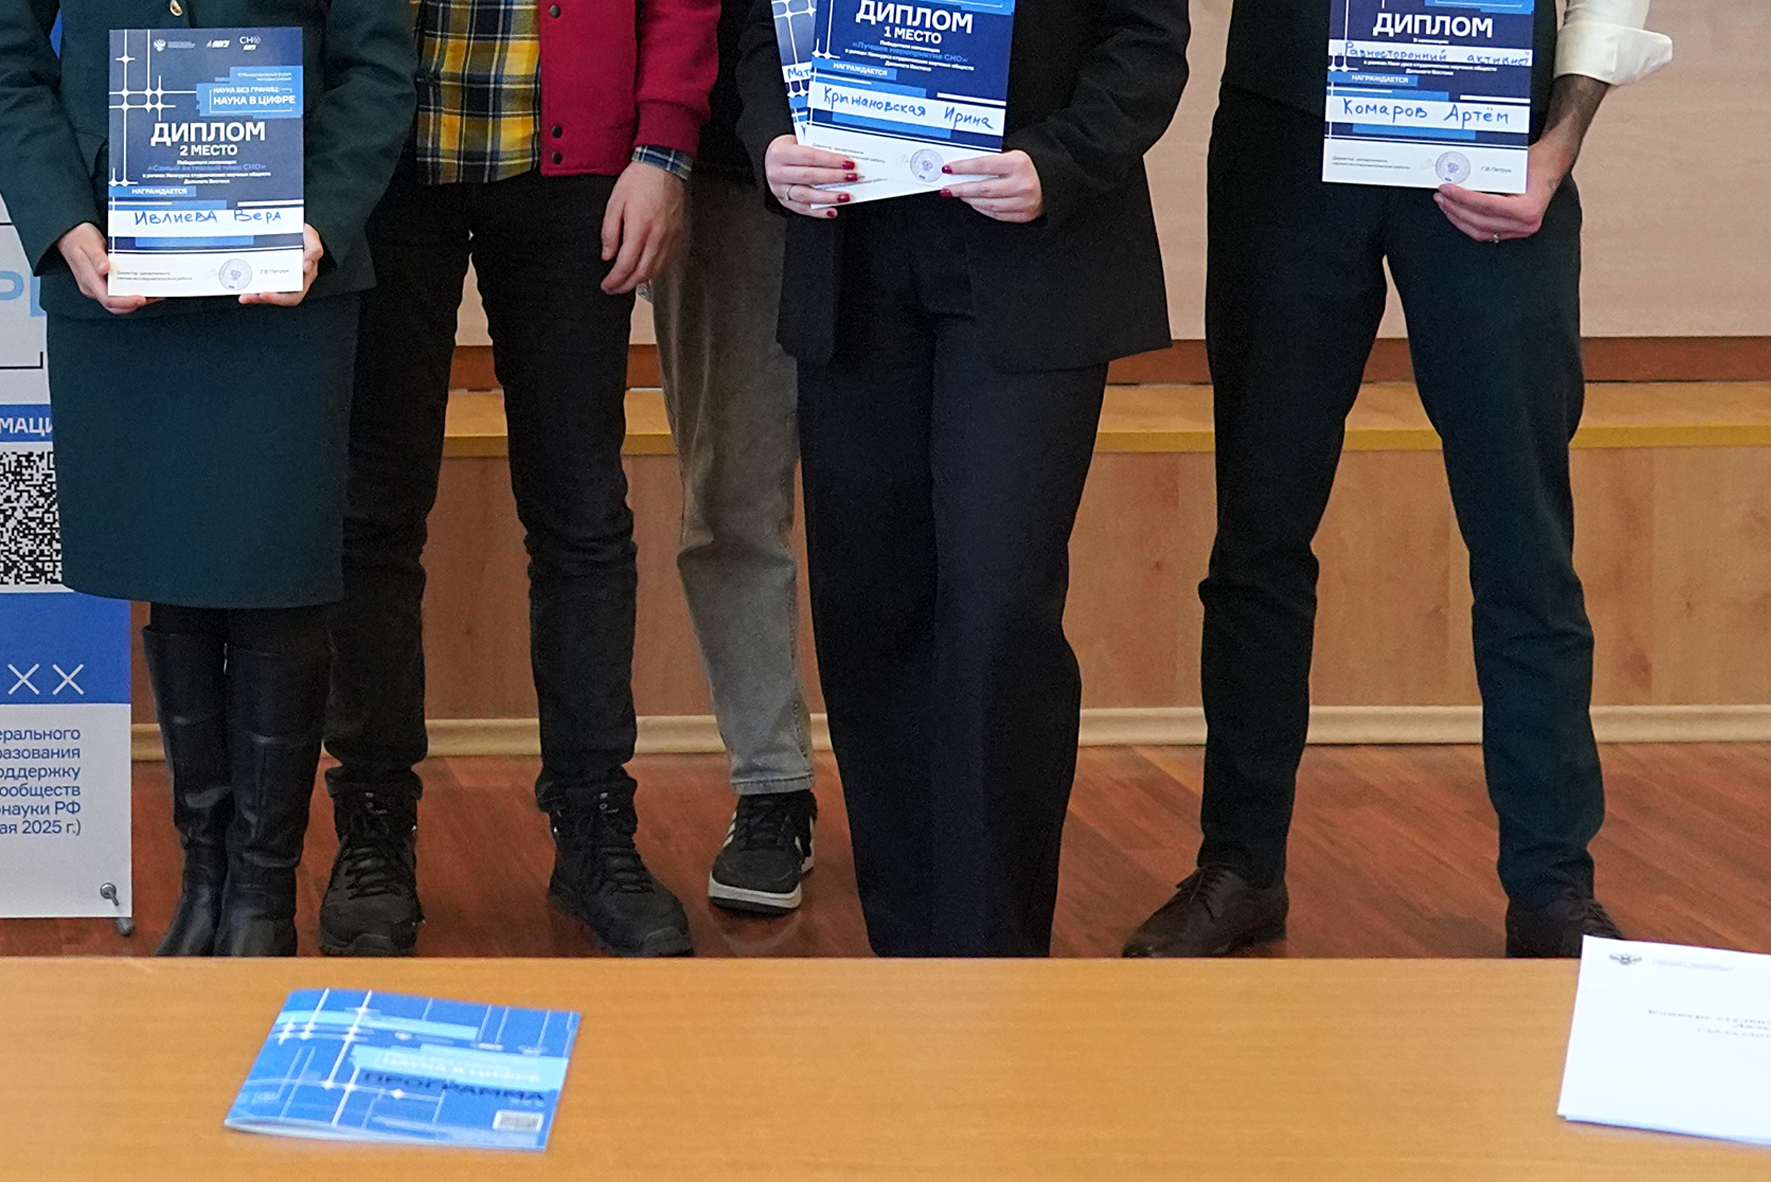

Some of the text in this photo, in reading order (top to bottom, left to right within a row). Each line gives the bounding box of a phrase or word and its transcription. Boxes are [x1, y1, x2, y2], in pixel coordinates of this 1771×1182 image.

[855, 0, 973, 34] ДИПЛОМ
[1372, 12, 1493, 38] ДИПЛОМ
[883, 26, 942, 44] 1 МЕСТО
[833, 62, 888, 76] НАГРАЖДАЕТСЯ
[1351, 74, 1409, 84] НАГРАЖДАЕТСЯ
[213, 94, 296, 106] НАУКА В ЦИФРЕ
[824, 86, 994, 130] Крыжановская Ирина
[1343, 98, 1509, 130] Комаров Артём
[150, 121, 266, 147] ДИПЛОМ
[179, 144, 238, 156] 2 МЕСТО
[131, 187, 188, 196] НАГРАЖДАЕТСЯ
[54, 800, 81, 816] РФ
[21, 820, 62, 835] 2025
